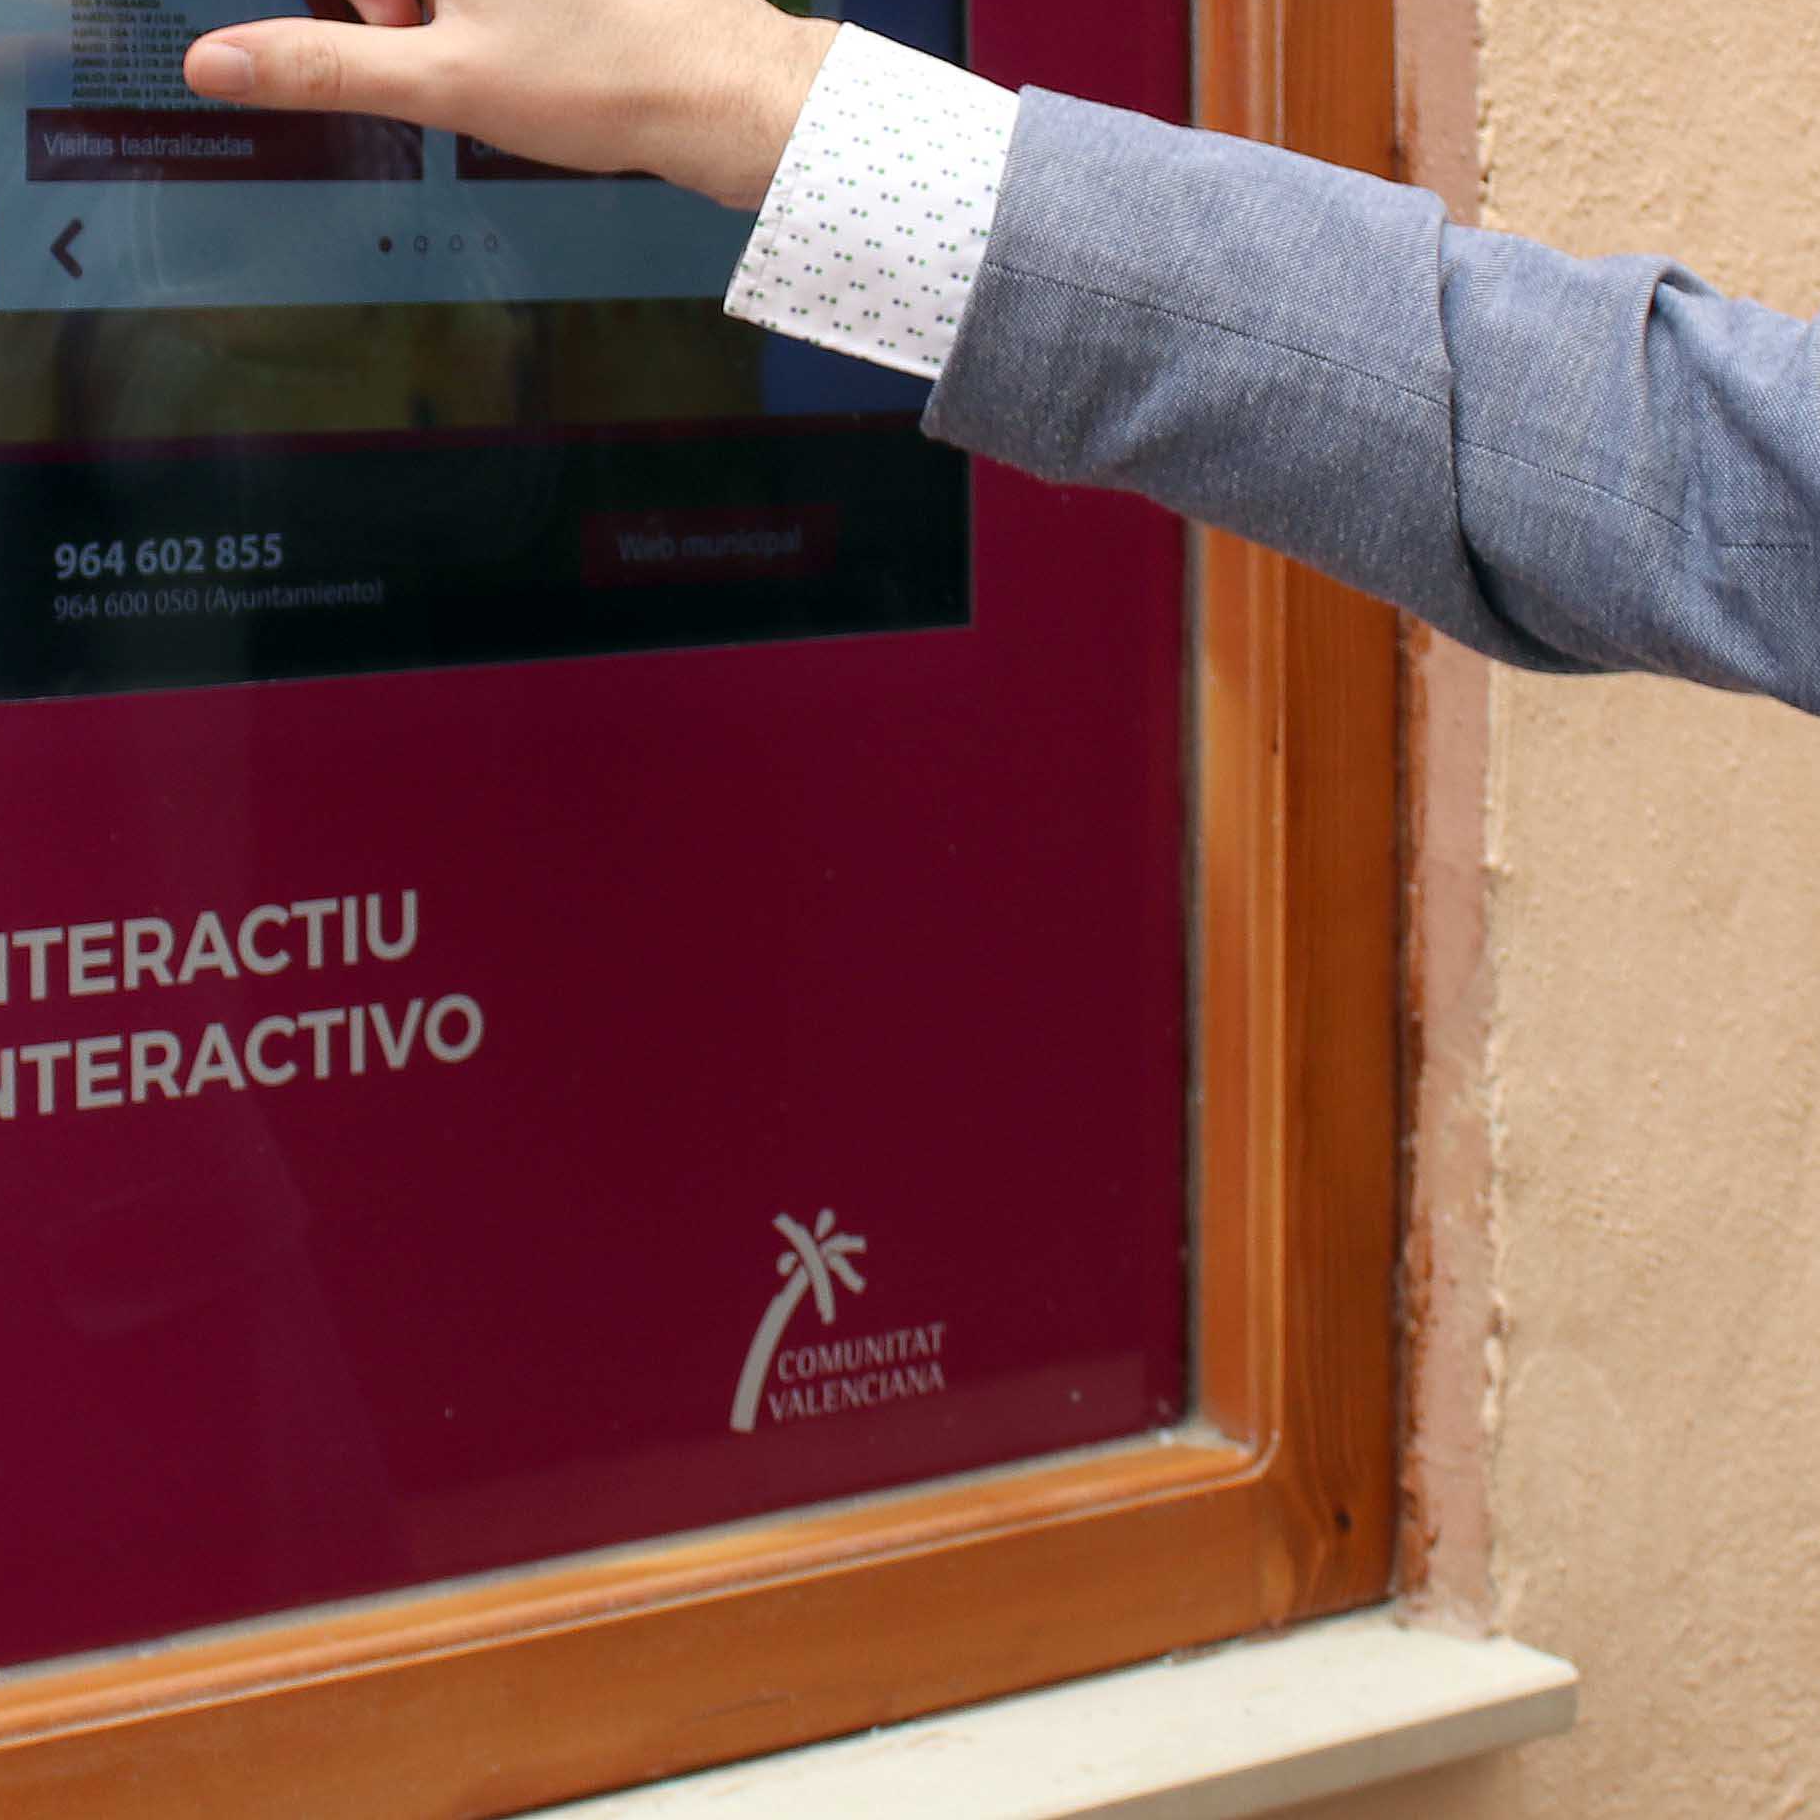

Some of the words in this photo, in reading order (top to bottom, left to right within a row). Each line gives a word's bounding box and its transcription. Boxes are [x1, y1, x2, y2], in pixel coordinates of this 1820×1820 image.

[43, 133, 115, 157] Visitas
[120, 132, 254, 157] teatralizadas
[54, 539, 126, 581] 964
[135, 537, 206, 576] 602
[214, 532, 284, 574] 855
[53, 593, 99, 623] 964
[103, 590, 150, 618] 600
[777, 1322, 945, 1381] COMUNITAT
[768, 1360, 946, 1422] VALENCIANA
